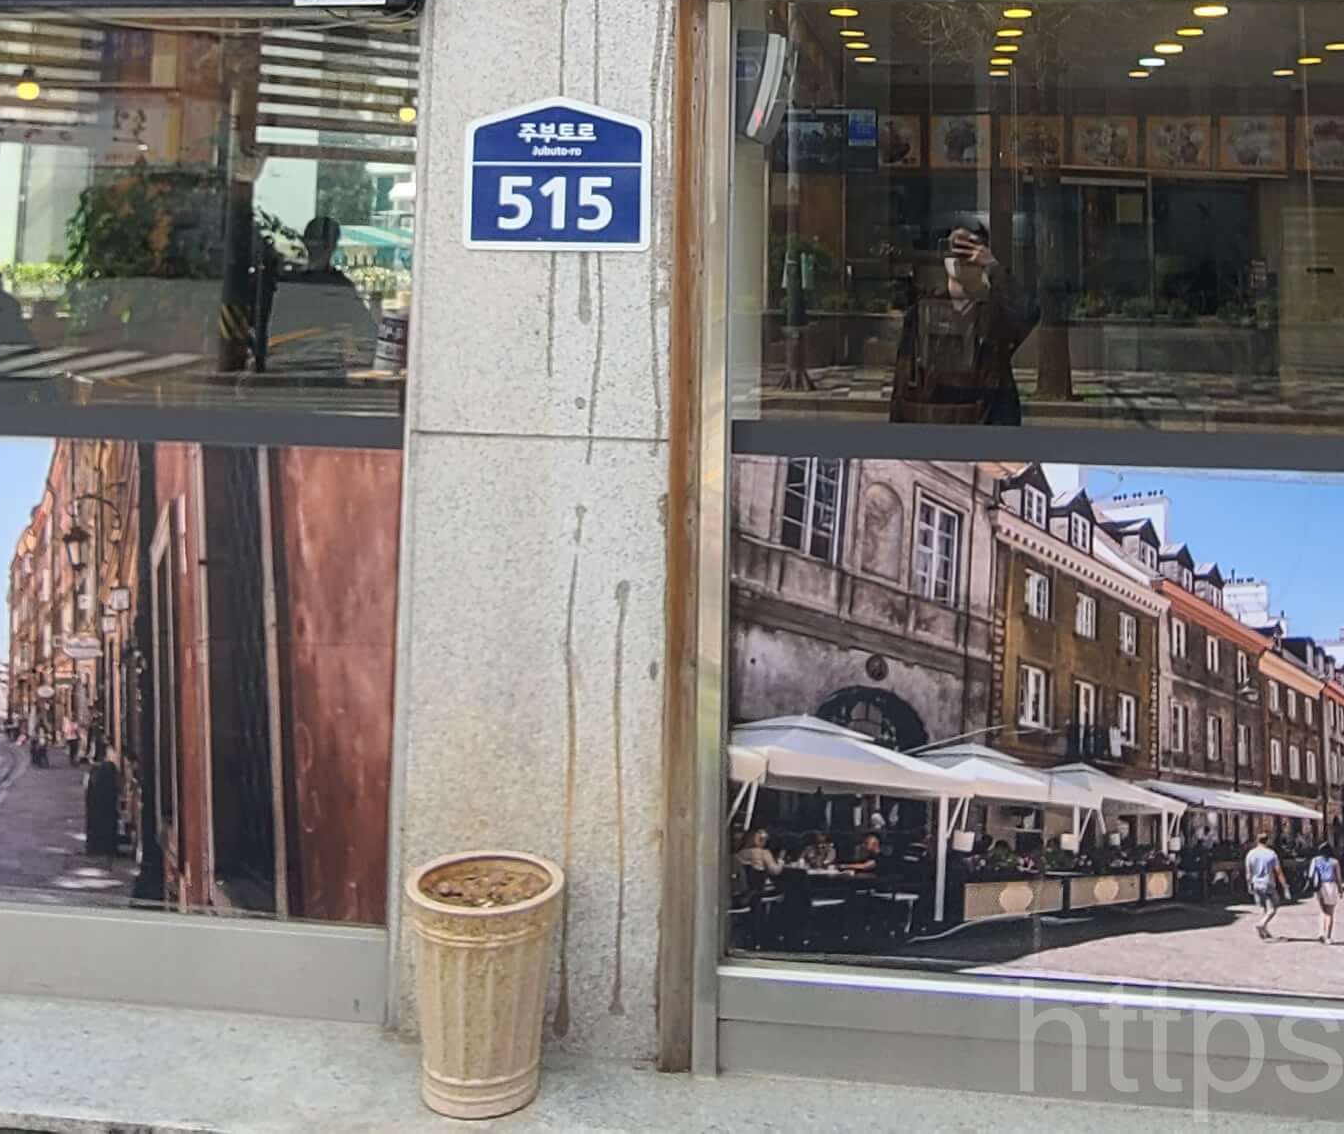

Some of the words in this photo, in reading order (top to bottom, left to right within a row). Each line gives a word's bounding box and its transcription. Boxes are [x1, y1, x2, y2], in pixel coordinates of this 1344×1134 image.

[517, 122, 598, 143] 주부토로
[531, 145, 583, 157] Jubuto-ro
[497, 176, 614, 231] 515
